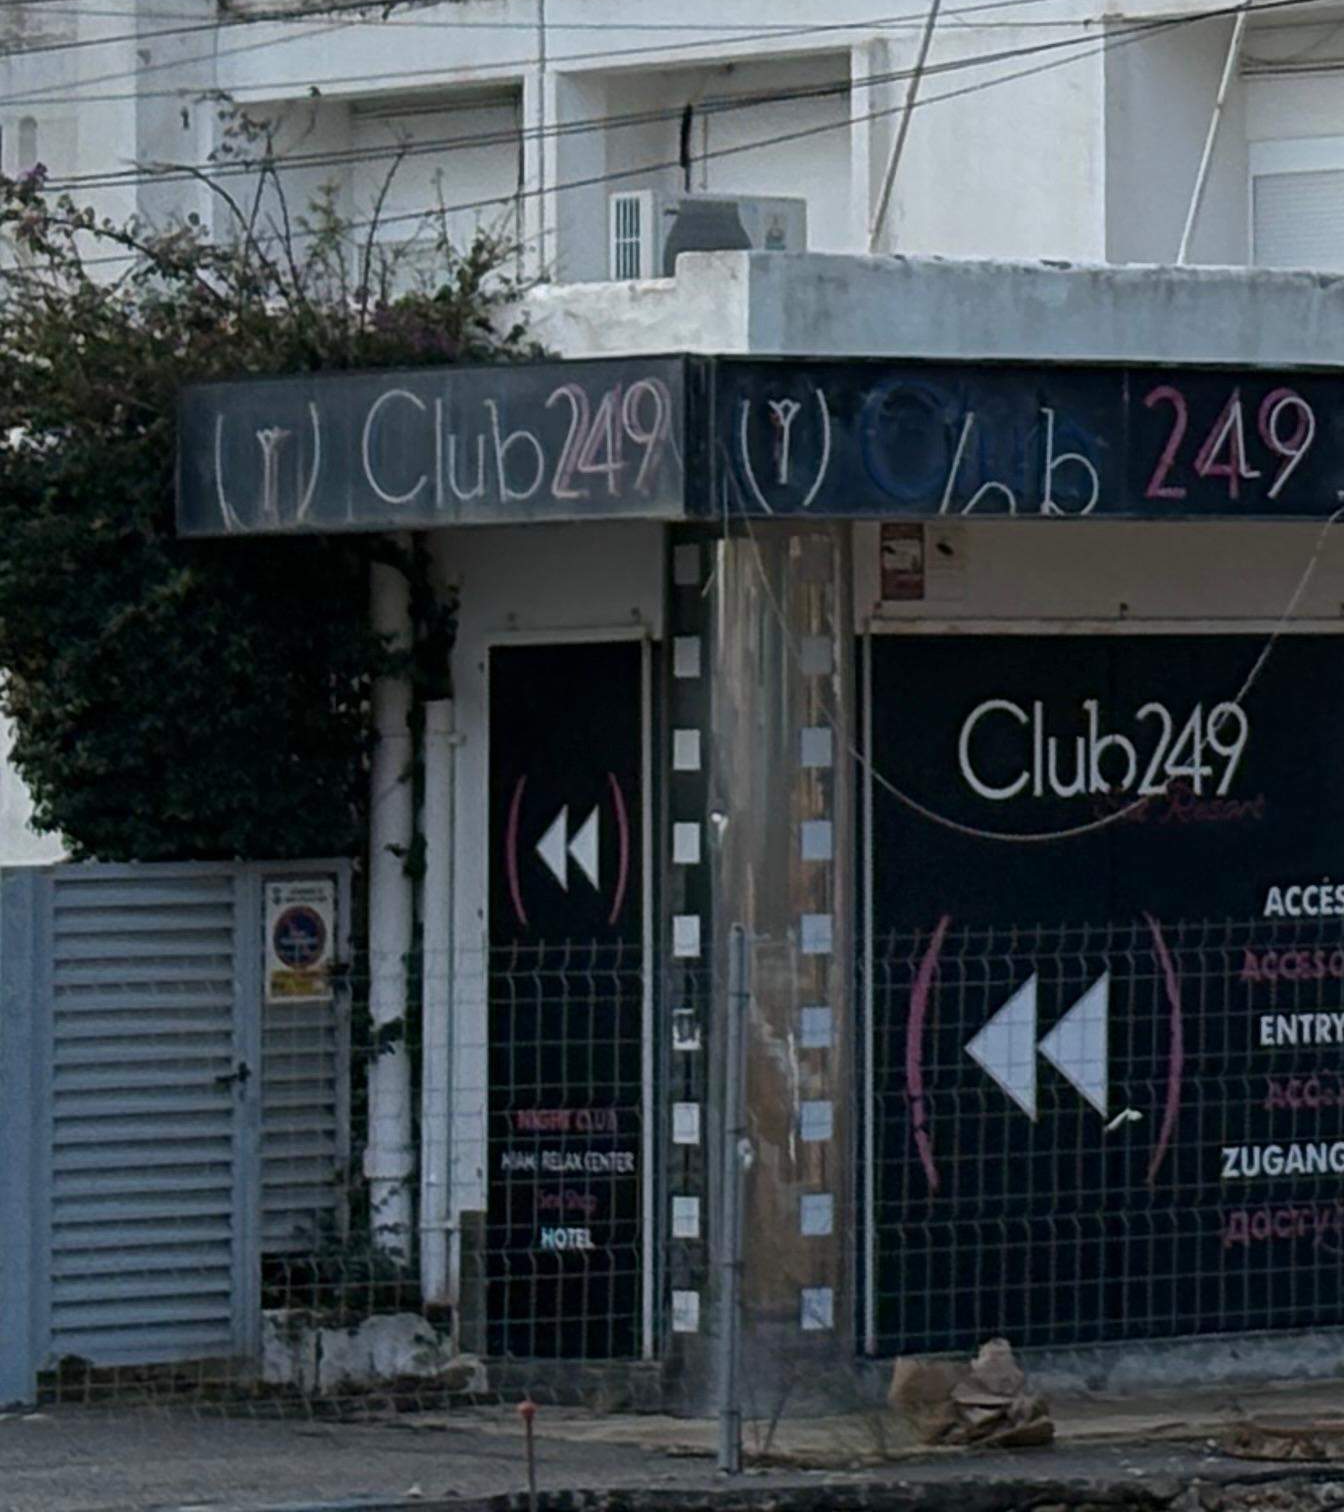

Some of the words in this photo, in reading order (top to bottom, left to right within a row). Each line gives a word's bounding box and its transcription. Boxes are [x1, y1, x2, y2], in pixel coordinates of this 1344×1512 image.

[1142, 386, 1316, 500] 249
[541, 1150, 583, 1171] RELAX
[584, 1151, 635, 1173] CENTER
[540, 1227, 596, 1249] HOTEL
